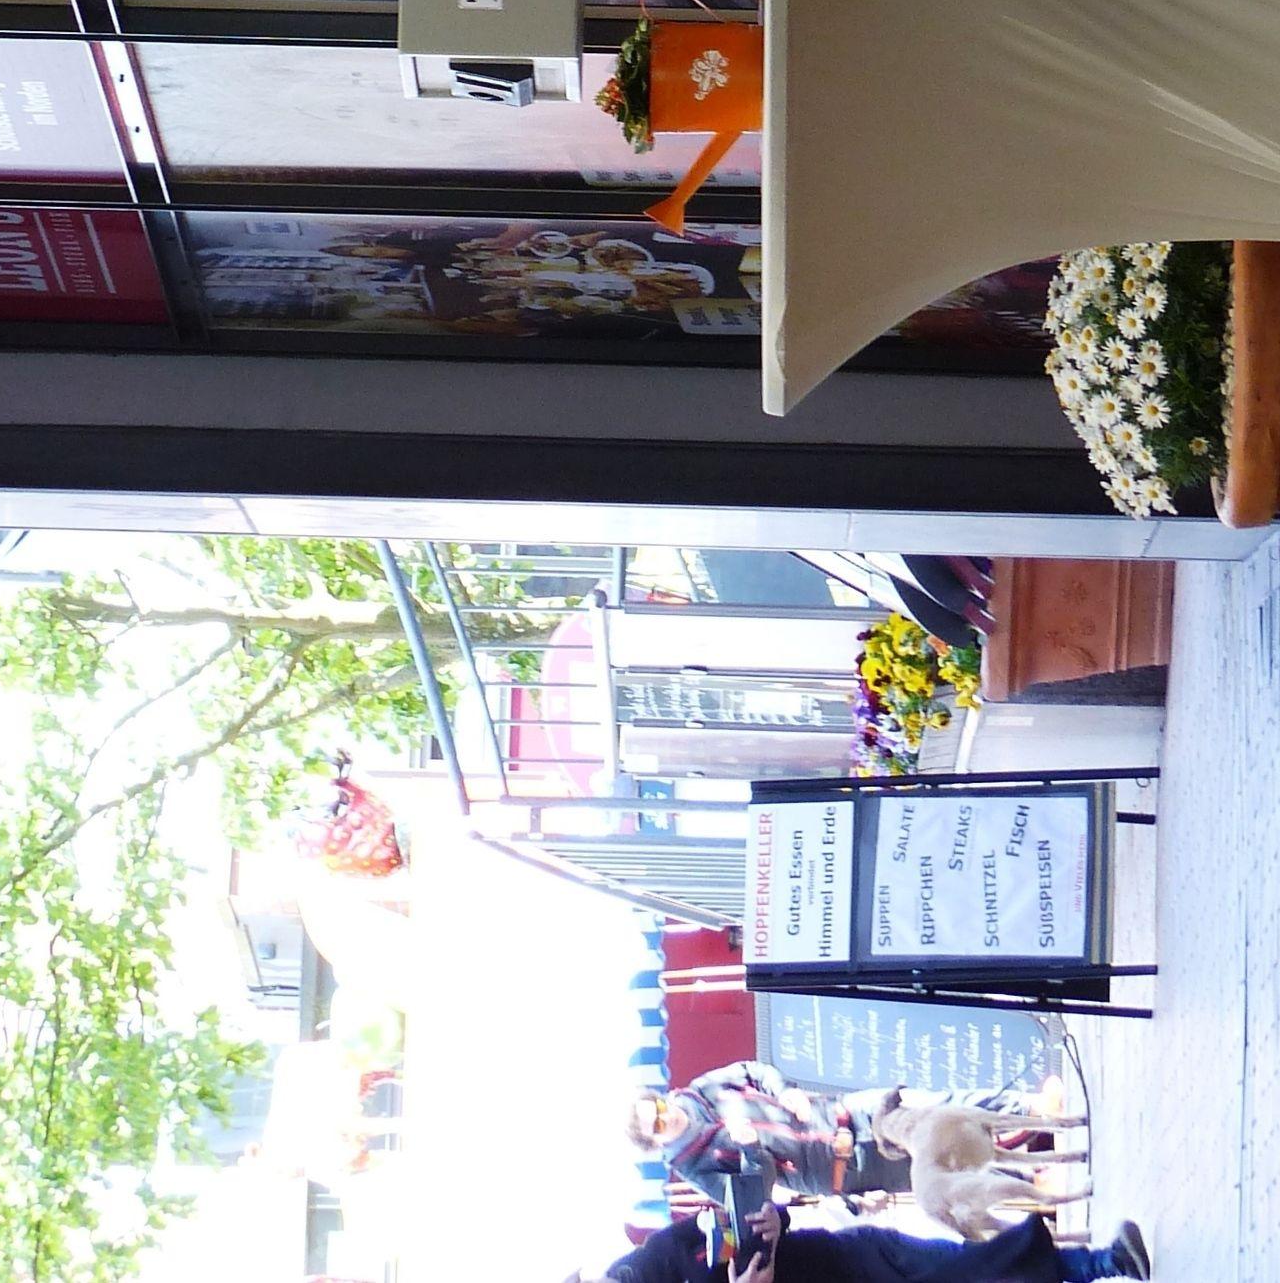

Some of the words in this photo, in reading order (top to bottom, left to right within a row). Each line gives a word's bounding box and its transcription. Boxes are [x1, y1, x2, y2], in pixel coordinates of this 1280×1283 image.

[17, 80, 54, 113] Norden
[788, 829, 803, 879] Essen
[822, 806, 836, 845] Erde
[892, 804, 916, 863] SALATE
[947, 805, 973, 871] STEAKS
[1005, 804, 1031, 858] FISCH
[754, 812, 773, 958] HOPFENKELLER
[821, 852, 835, 884] und
[786, 885, 801, 936] Gutes
[818, 890, 834, 958] Himmel
[878, 885, 892, 947] SUPPEN
[919, 855, 936, 945] RIPPCHEN
[982, 849, 1000, 947] SCHNITZEL
